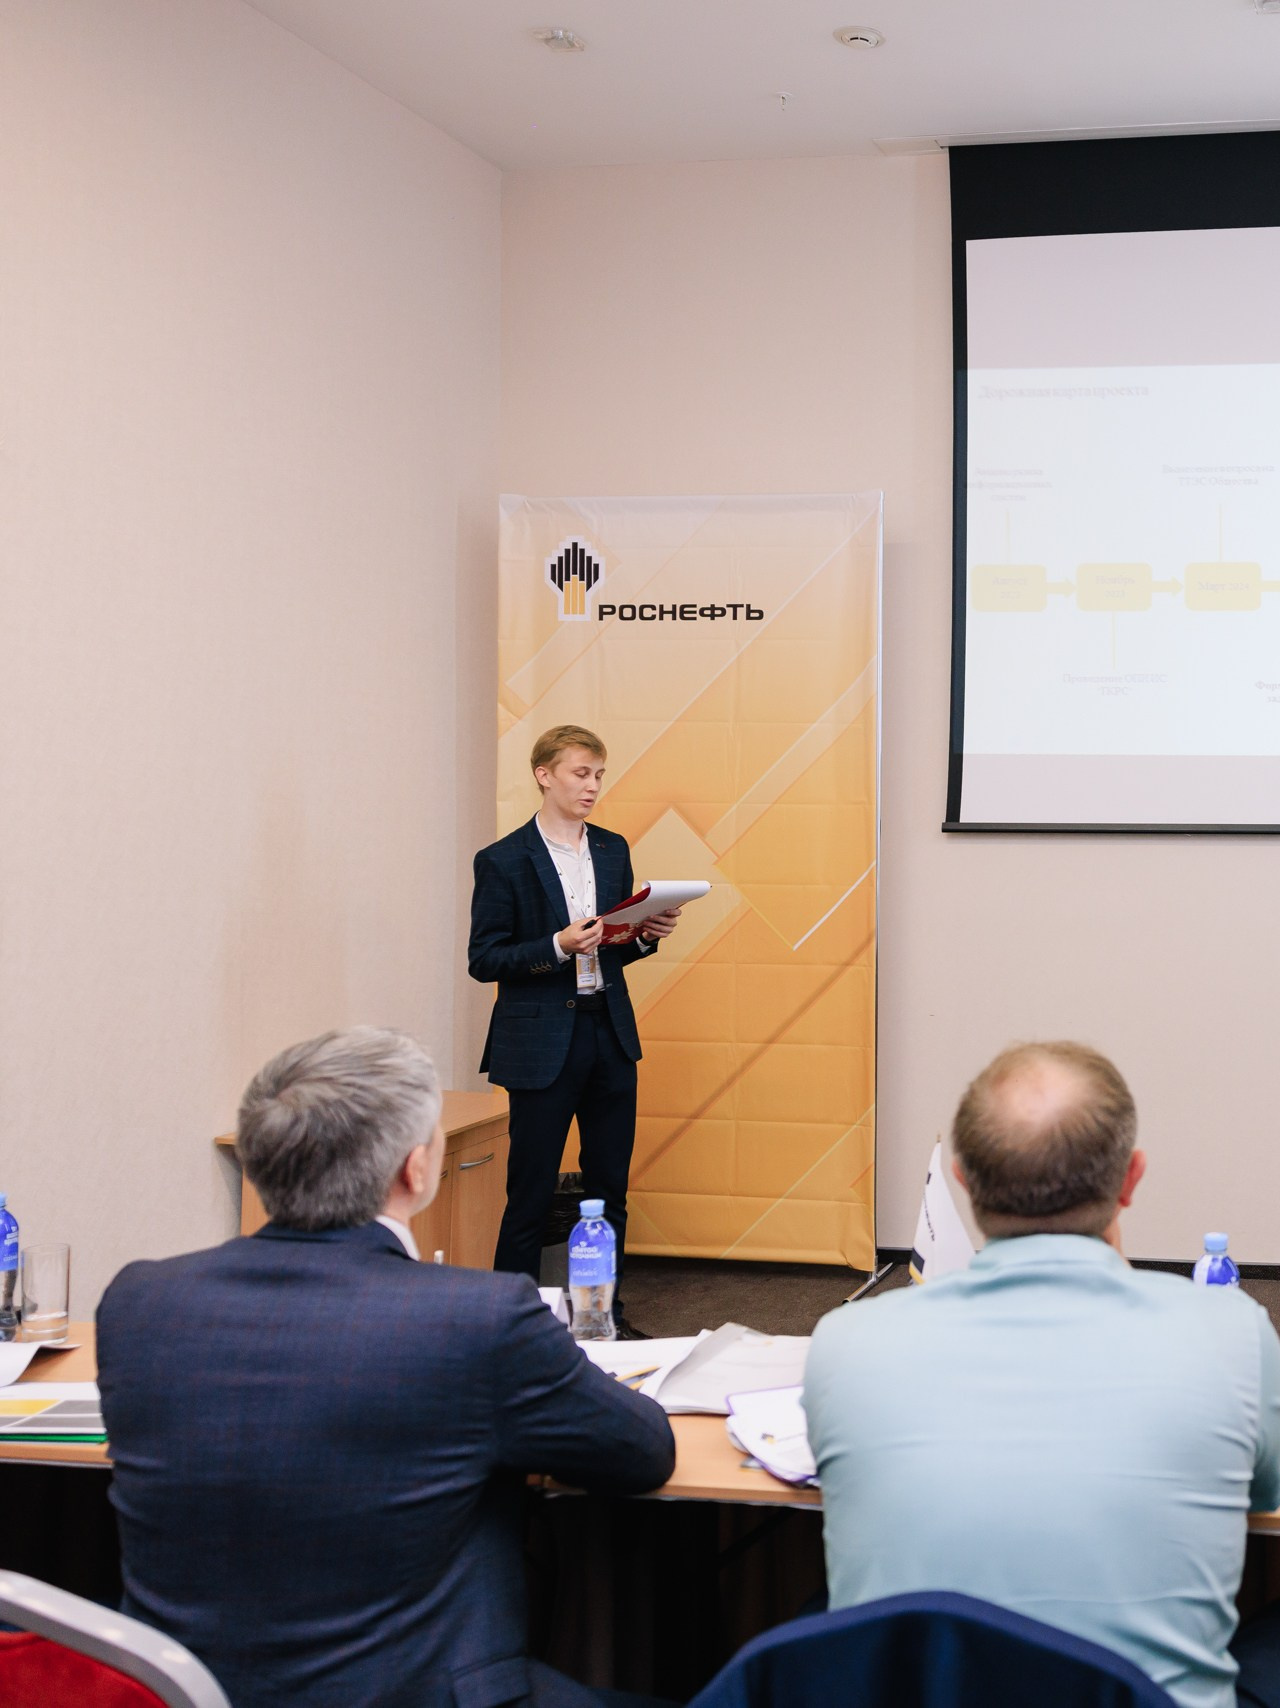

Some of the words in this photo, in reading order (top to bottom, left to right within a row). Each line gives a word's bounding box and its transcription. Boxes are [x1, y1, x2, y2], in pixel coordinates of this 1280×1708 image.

[1052, 387, 1091, 400] карта
[1092, 385, 1150, 399] проекта
[1095, 574, 1136, 587] Ноябрь
[1197, 580, 1227, 592] Март
[1229, 582, 1250, 591] 2024
[598, 603, 765, 621] РОСНЕФТЬ
